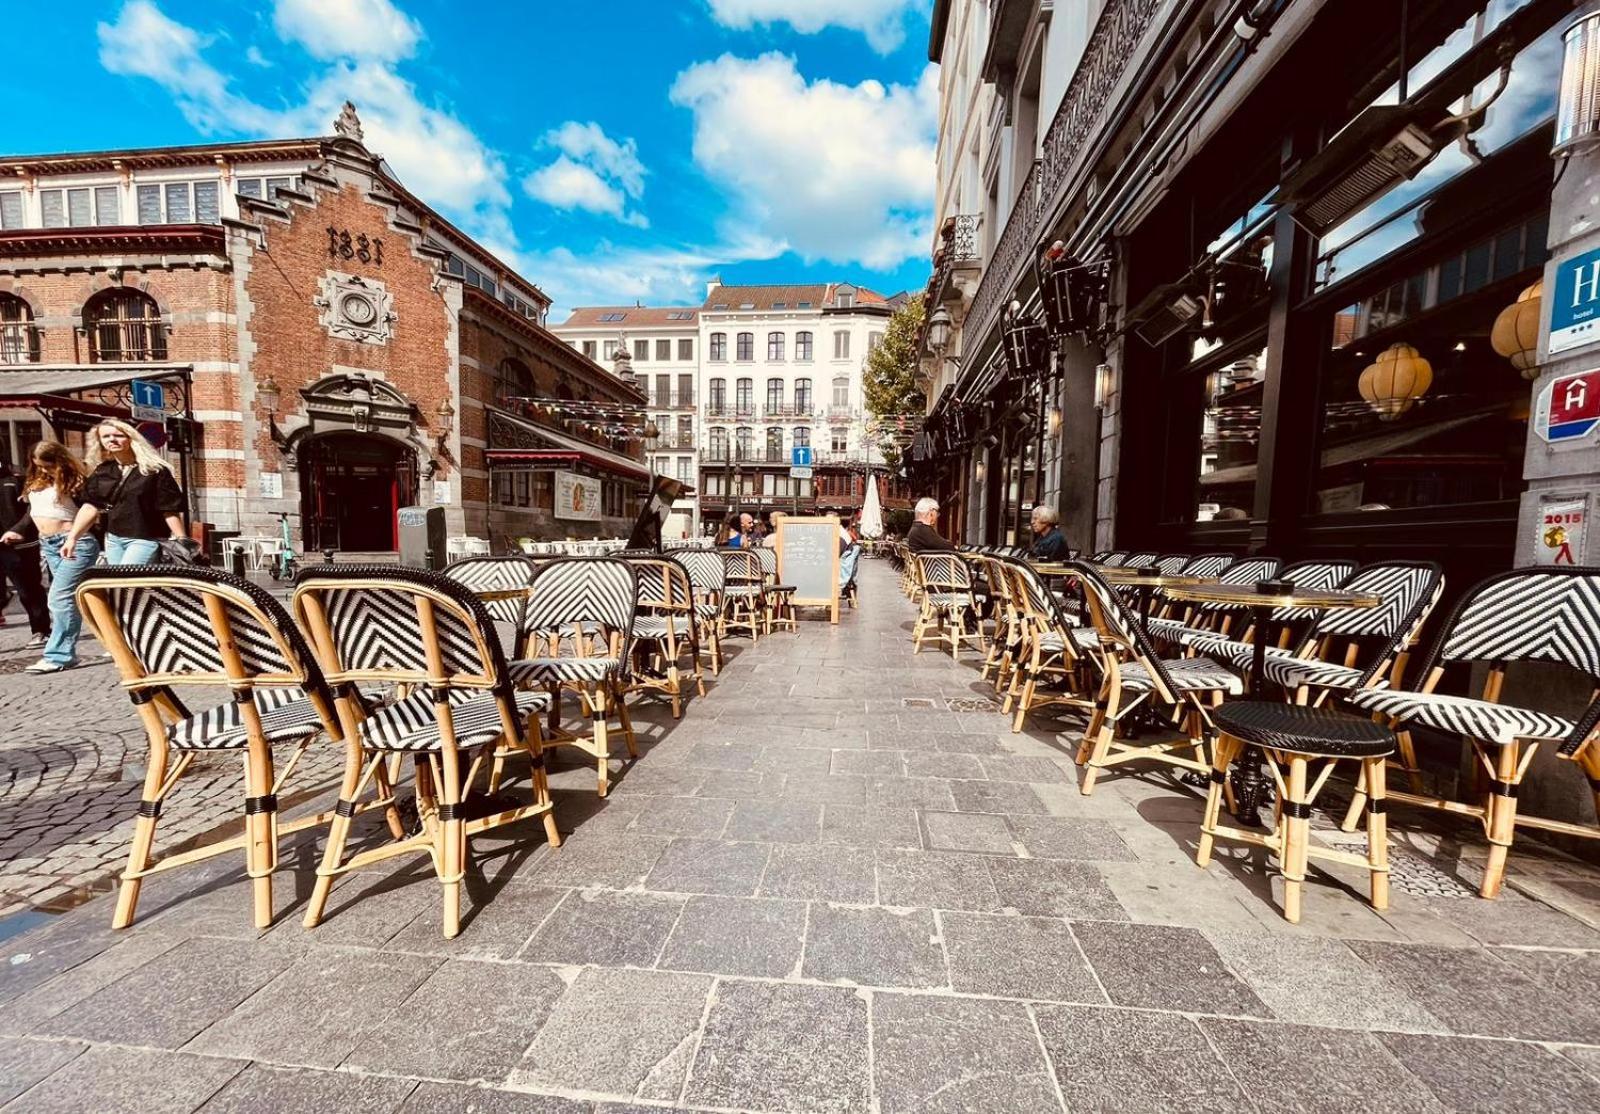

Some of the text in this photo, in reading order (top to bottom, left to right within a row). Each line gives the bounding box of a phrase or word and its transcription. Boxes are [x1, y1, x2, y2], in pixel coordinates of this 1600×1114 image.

[325, 225, 385, 266] 1881
[1570, 259, 1600, 308] H
[1544, 513, 1582, 524] 2015
